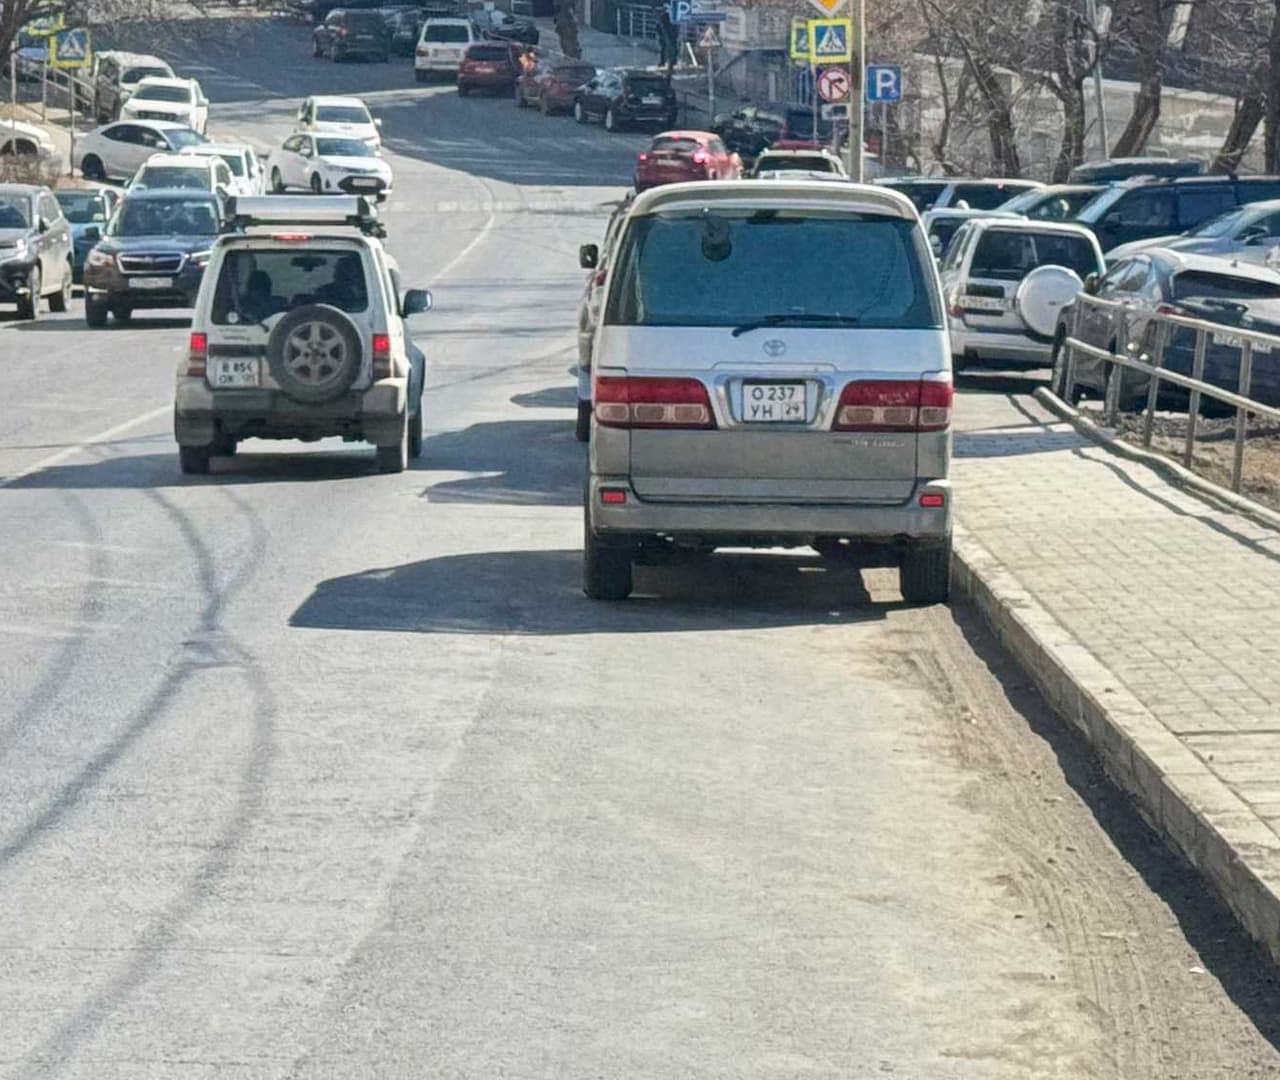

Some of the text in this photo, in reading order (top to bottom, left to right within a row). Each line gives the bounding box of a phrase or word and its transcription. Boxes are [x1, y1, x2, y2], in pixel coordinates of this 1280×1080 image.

[676, 1, 690, 21] P
[875, 69, 897, 98] P
[767, 387, 795, 400] 237
